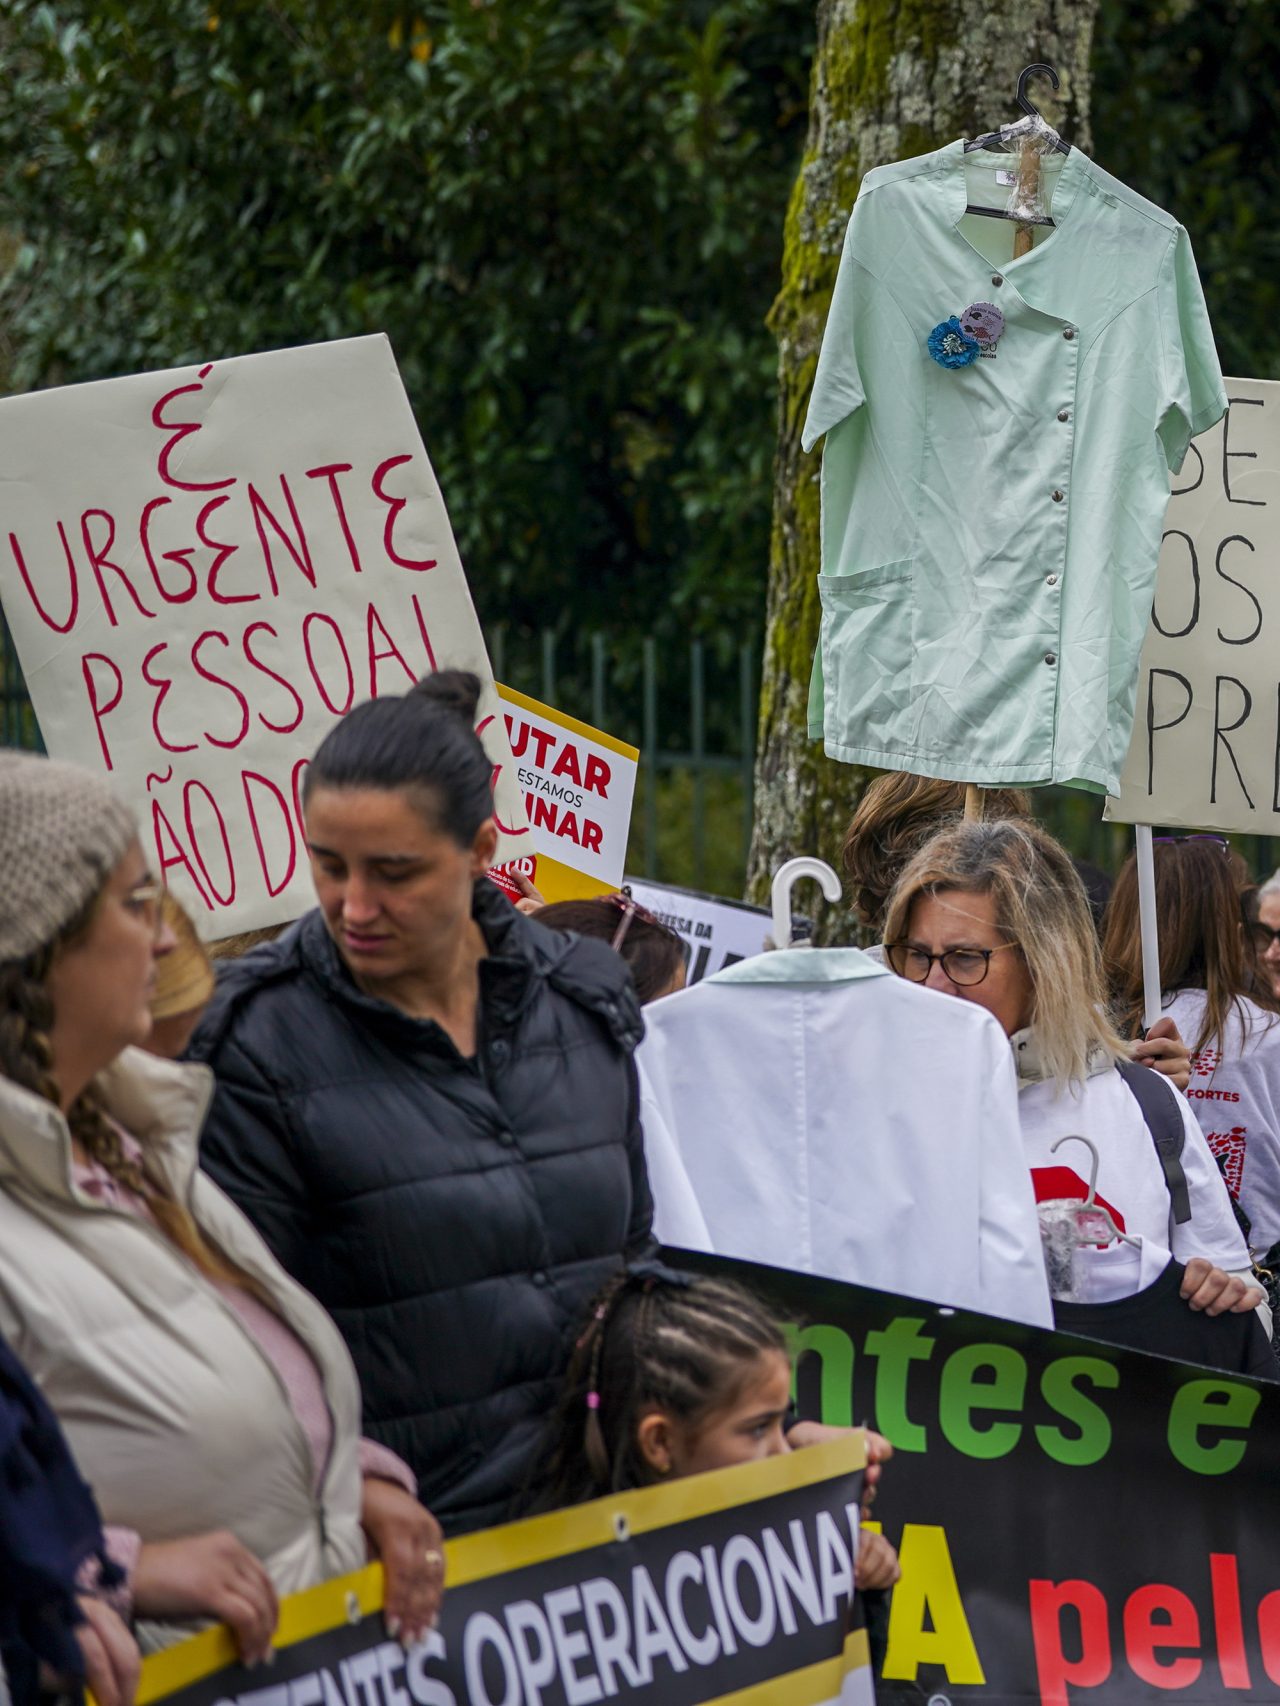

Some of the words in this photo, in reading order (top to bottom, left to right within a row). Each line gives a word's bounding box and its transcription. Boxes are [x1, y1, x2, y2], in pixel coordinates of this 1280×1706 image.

[152, 364, 237, 492] É
[9, 455, 437, 633] URGENTE
[517, 767, 584, 808] ESTAMOS
[521, 788, 604, 855] INAR
[694, 922, 713, 941] DA
[1187, 1089, 1240, 1103] FORTES
[1167, 1379, 1262, 1477] e
[859, 1521, 987, 1685] A
